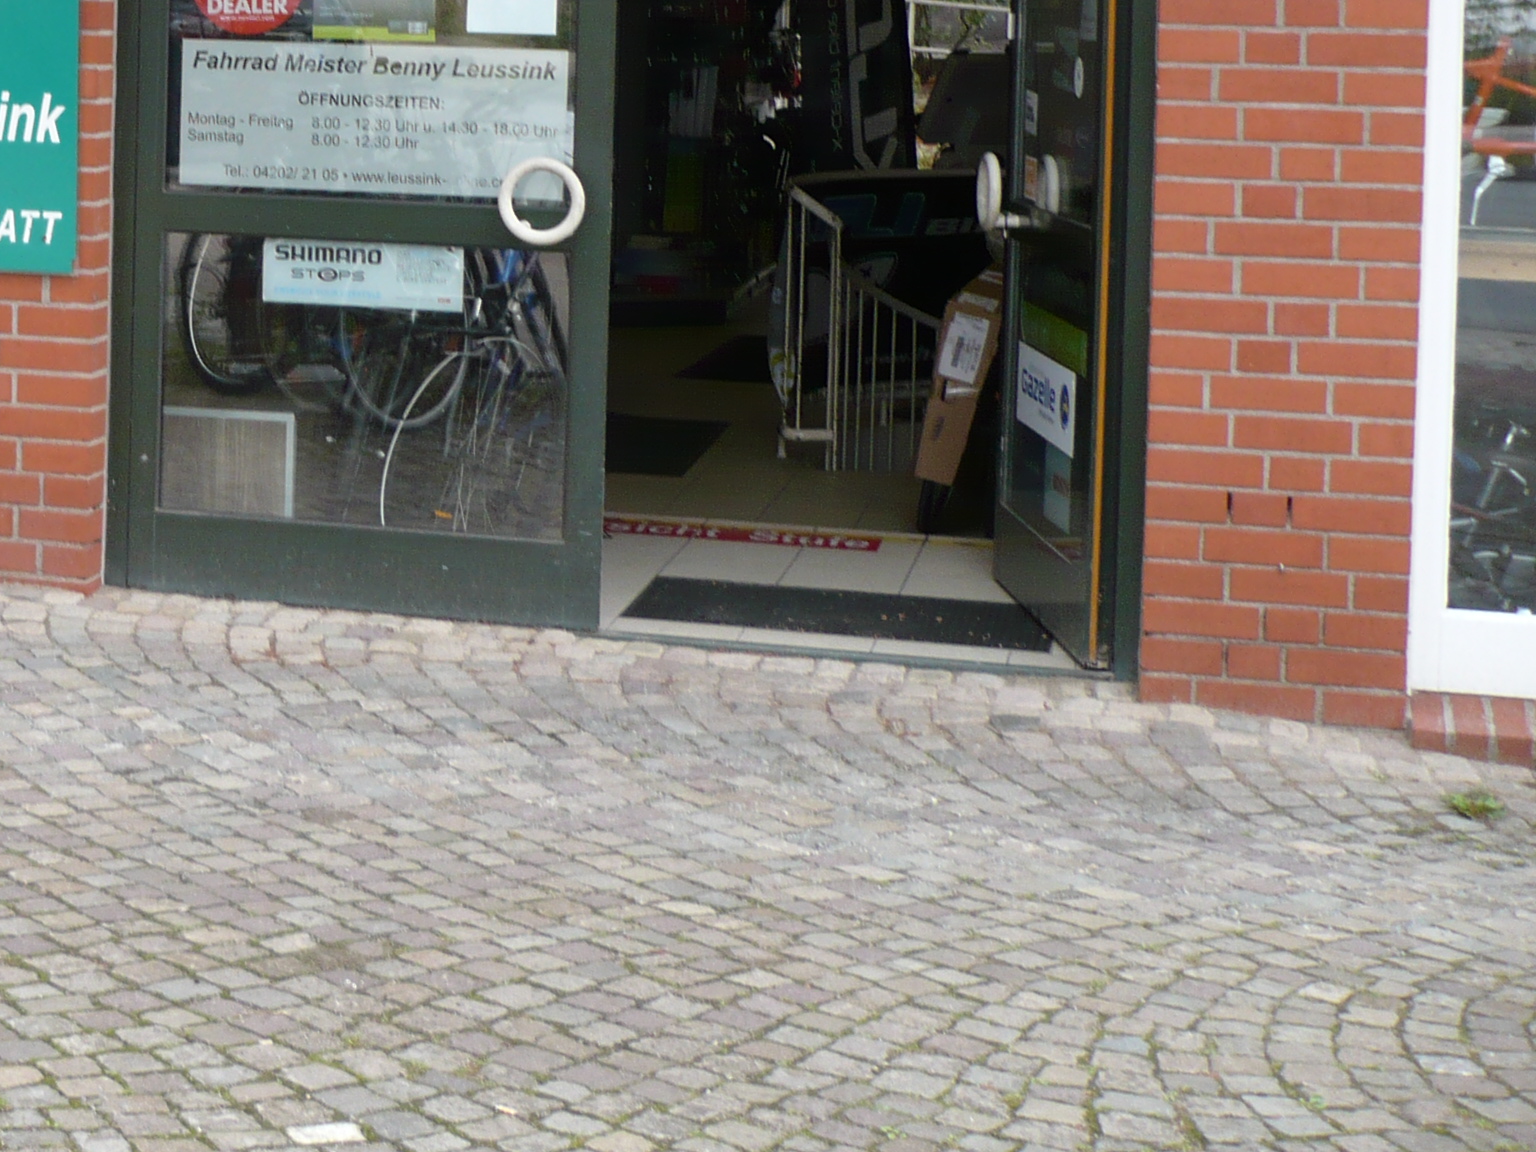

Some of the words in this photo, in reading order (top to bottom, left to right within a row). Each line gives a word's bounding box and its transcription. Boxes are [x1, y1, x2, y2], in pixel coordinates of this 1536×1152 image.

[193, 50, 278, 71] Fahrrad
[285, 54, 367, 74] Meister
[373, 56, 445, 81] Benny
[452, 58, 557, 80] Leussink
[298, 90, 445, 110] ÖFFNUNGSZEITEN:
[187, 112, 235, 128] Montag
[249, 114, 293, 131] Freitag
[311, 116, 341, 130] 8.00
[355, 118, 391, 133] 12.30
[395, 120, 418, 133] Uhr
[494, 123, 529, 138] 18.00
[534, 124, 558, 138] Uhr
[187, 129, 244, 145] Samstag
[311, 133, 341, 147] 8.00
[355, 136, 391, 149] 12.30
[395, 137, 419, 150] Uhr
[223, 164, 249, 177] Tel.:
[253, 165, 298, 180] 04202/
[302, 167, 317, 180] 21
[322, 168, 339, 182] 05
[275, 244, 382, 265] SHIMANO
[1022, 368, 1056, 414] Gazelle
[749, 529, 870, 548] Stufe
